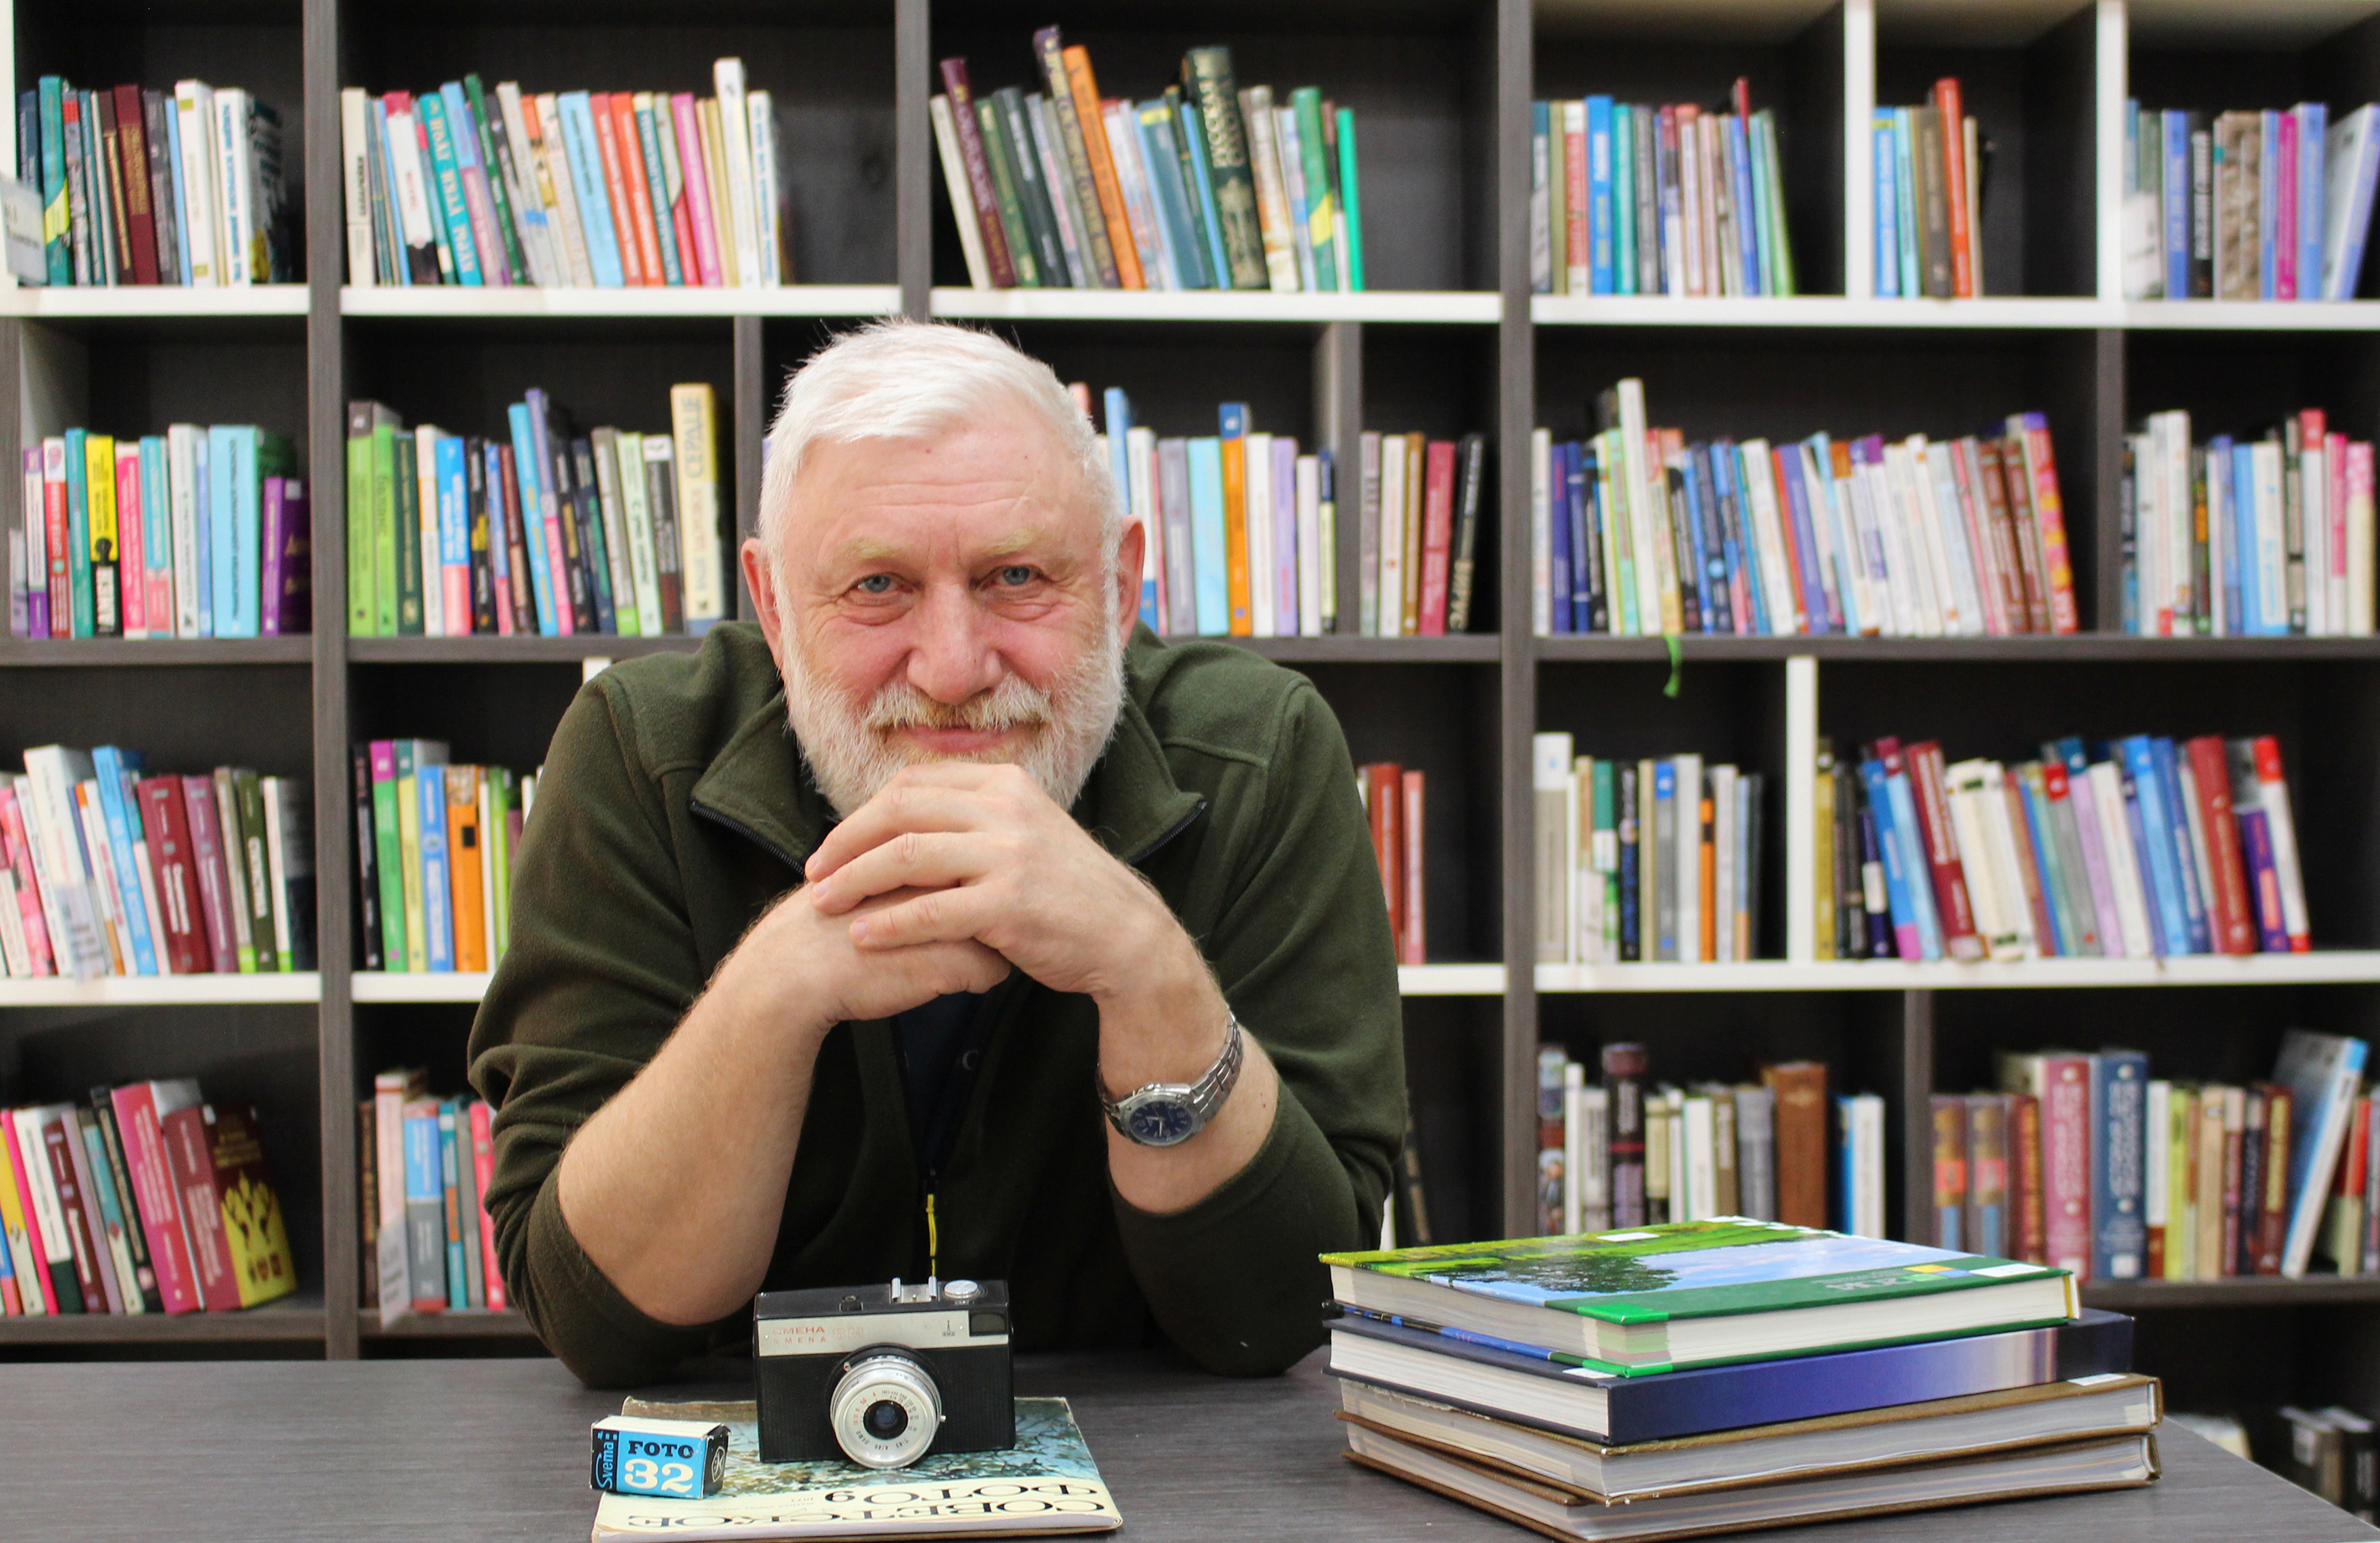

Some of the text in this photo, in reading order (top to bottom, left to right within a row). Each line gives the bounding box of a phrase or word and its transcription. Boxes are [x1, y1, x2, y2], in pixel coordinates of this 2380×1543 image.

[1198, 81, 1228, 167] РУССКАЯ
[440, 168, 467, 216] УТКИ
[451, 225, 477, 272] КУРЫ
[680, 395, 708, 478] СЕРДЦЕ
[773, 1326, 826, 1336] СМЕНА
[774, 1336, 827, 1345] SMENA
[596, 1441, 615, 1489] Svema
[628, 1440, 694, 1459] FOTO
[624, 1458, 693, 1493] 32
[825, 1482, 1099, 1505] ФОТО 9
[628, 1499, 1105, 1528] СОВЕТСКОЕ
